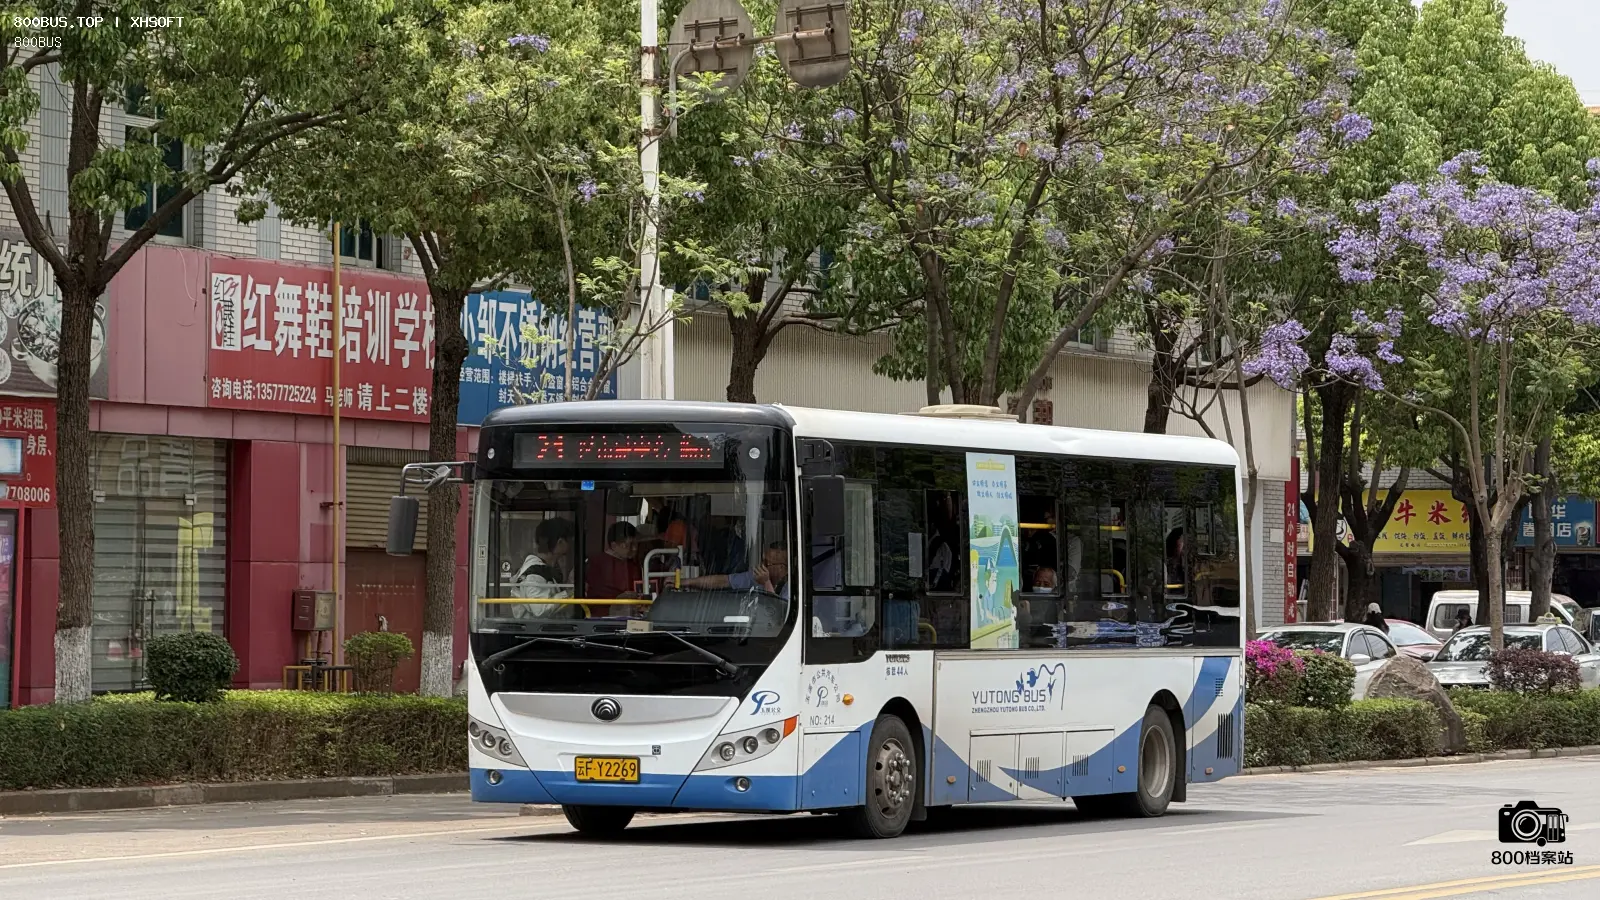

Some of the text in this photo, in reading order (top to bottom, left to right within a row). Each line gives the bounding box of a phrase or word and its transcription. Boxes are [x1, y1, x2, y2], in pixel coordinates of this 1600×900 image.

[972, 689, 1047, 705] YUTONG BUS
[823, 714, 835, 726] 214
